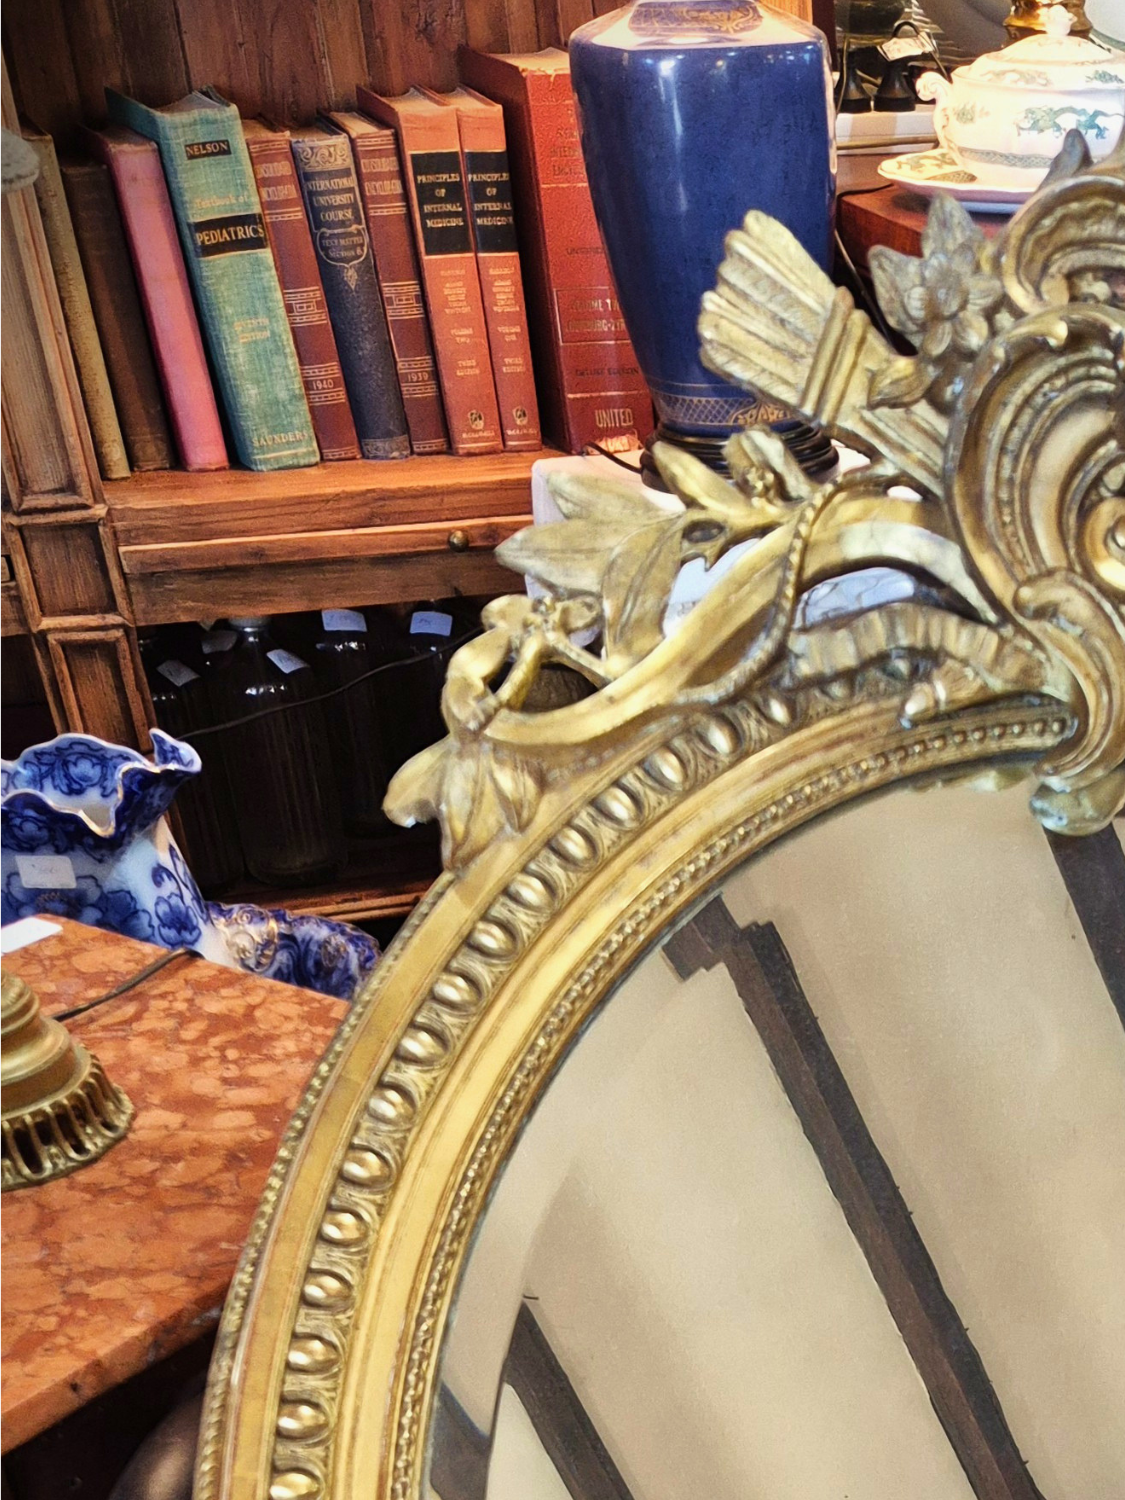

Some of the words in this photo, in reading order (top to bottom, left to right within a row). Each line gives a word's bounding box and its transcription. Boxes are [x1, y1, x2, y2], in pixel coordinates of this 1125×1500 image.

[185, 141, 229, 156] NELSON
[417, 173, 460, 184] PRINCIPLES
[435, 188, 446, 197] OF
[486, 187, 497, 196] OF
[313, 193, 354, 207] UNIVERSITY
[423, 203, 462, 213] INTERNAL
[474, 202, 512, 211] INTERNAL
[320, 209, 354, 222] COURSE
[426, 217, 464, 228] MEDICINE
[196, 224, 265, 245] PEDIATRICS
[407, 371, 429, 382] 1939
[313, 379, 334, 390] 1940
[594, 408, 634, 428] UNITED
[252, 431, 308, 447] SAUNDERS
